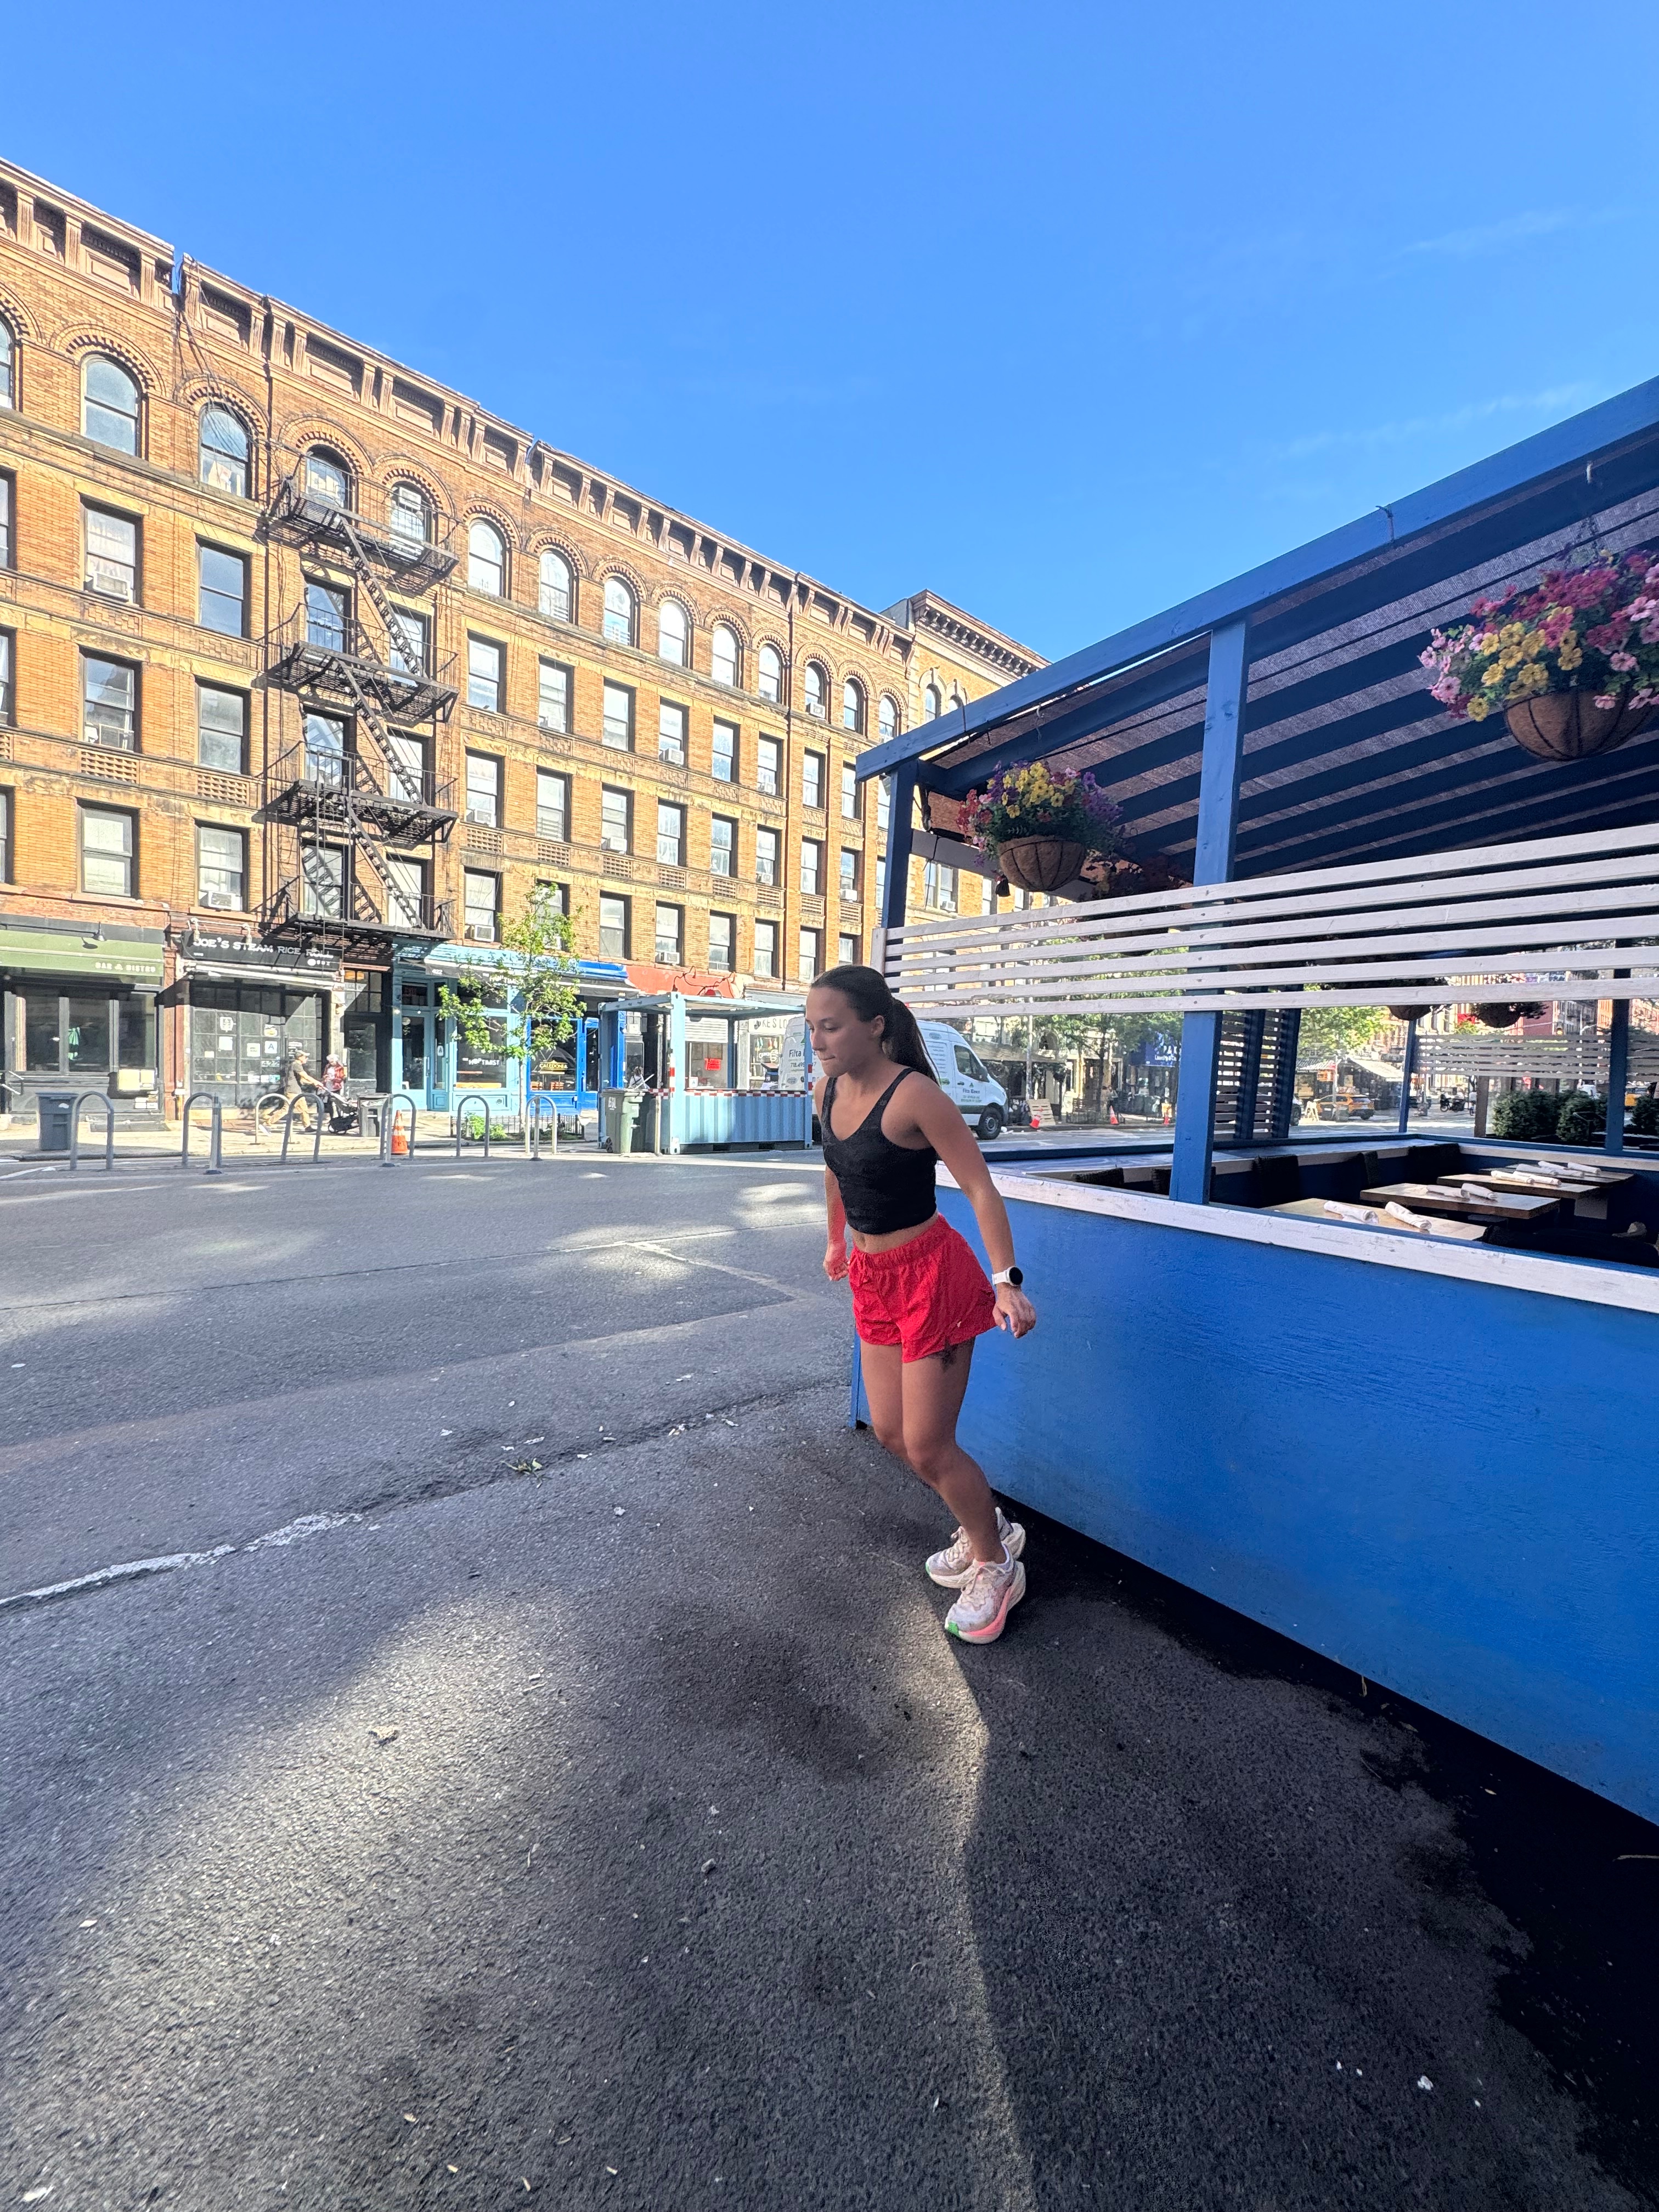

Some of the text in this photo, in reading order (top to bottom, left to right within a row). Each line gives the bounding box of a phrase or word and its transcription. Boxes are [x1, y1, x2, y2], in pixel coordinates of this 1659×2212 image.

[193, 937, 230, 949] JOE'S
[233, 941, 273, 953] STEAM
[277, 945, 301, 955] RICE
[788, 1049, 802, 1058] Filta
[262, 1059, 280, 1068] 422
